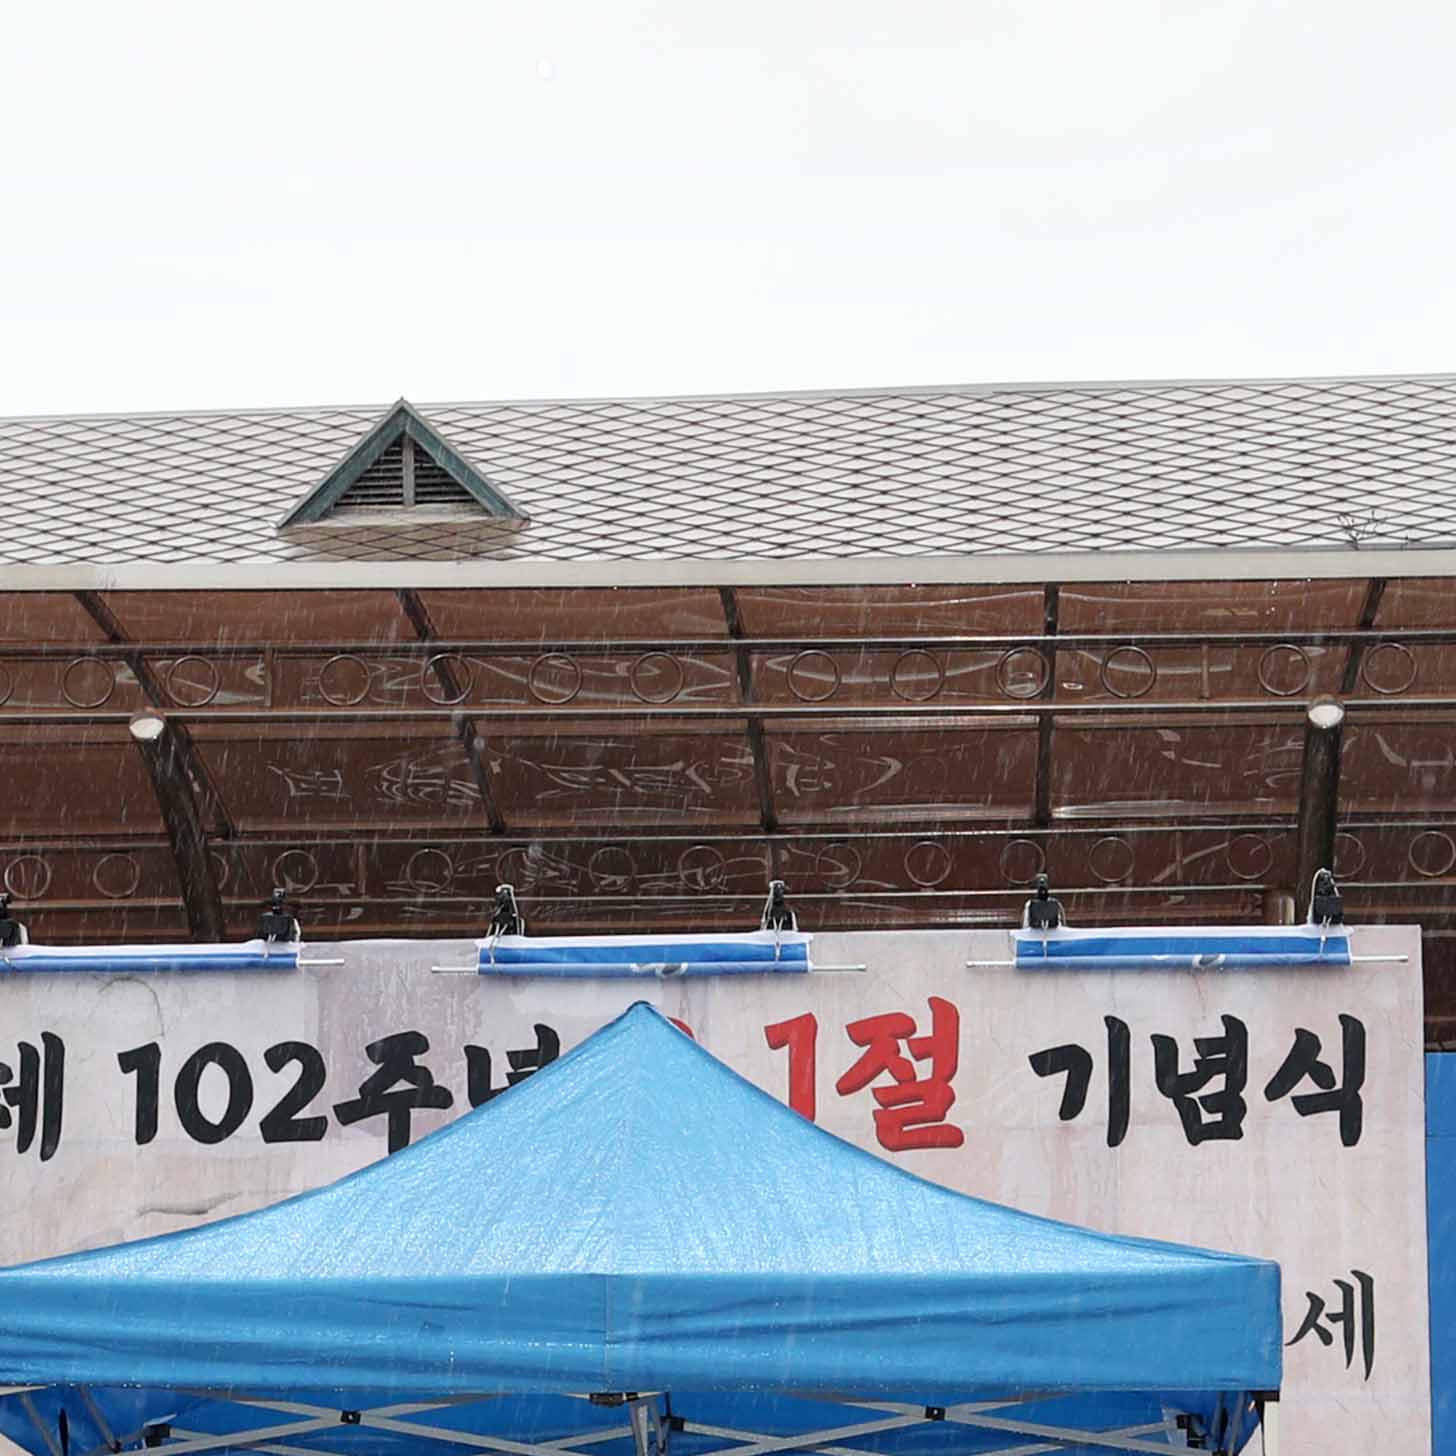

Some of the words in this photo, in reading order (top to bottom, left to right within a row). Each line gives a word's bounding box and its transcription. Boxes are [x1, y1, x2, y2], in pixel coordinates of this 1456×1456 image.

[666, 996, 965, 1151] 1절
[1028, 1014, 1366, 1148] 기념식
[1287, 1270, 1376, 1381] 세
